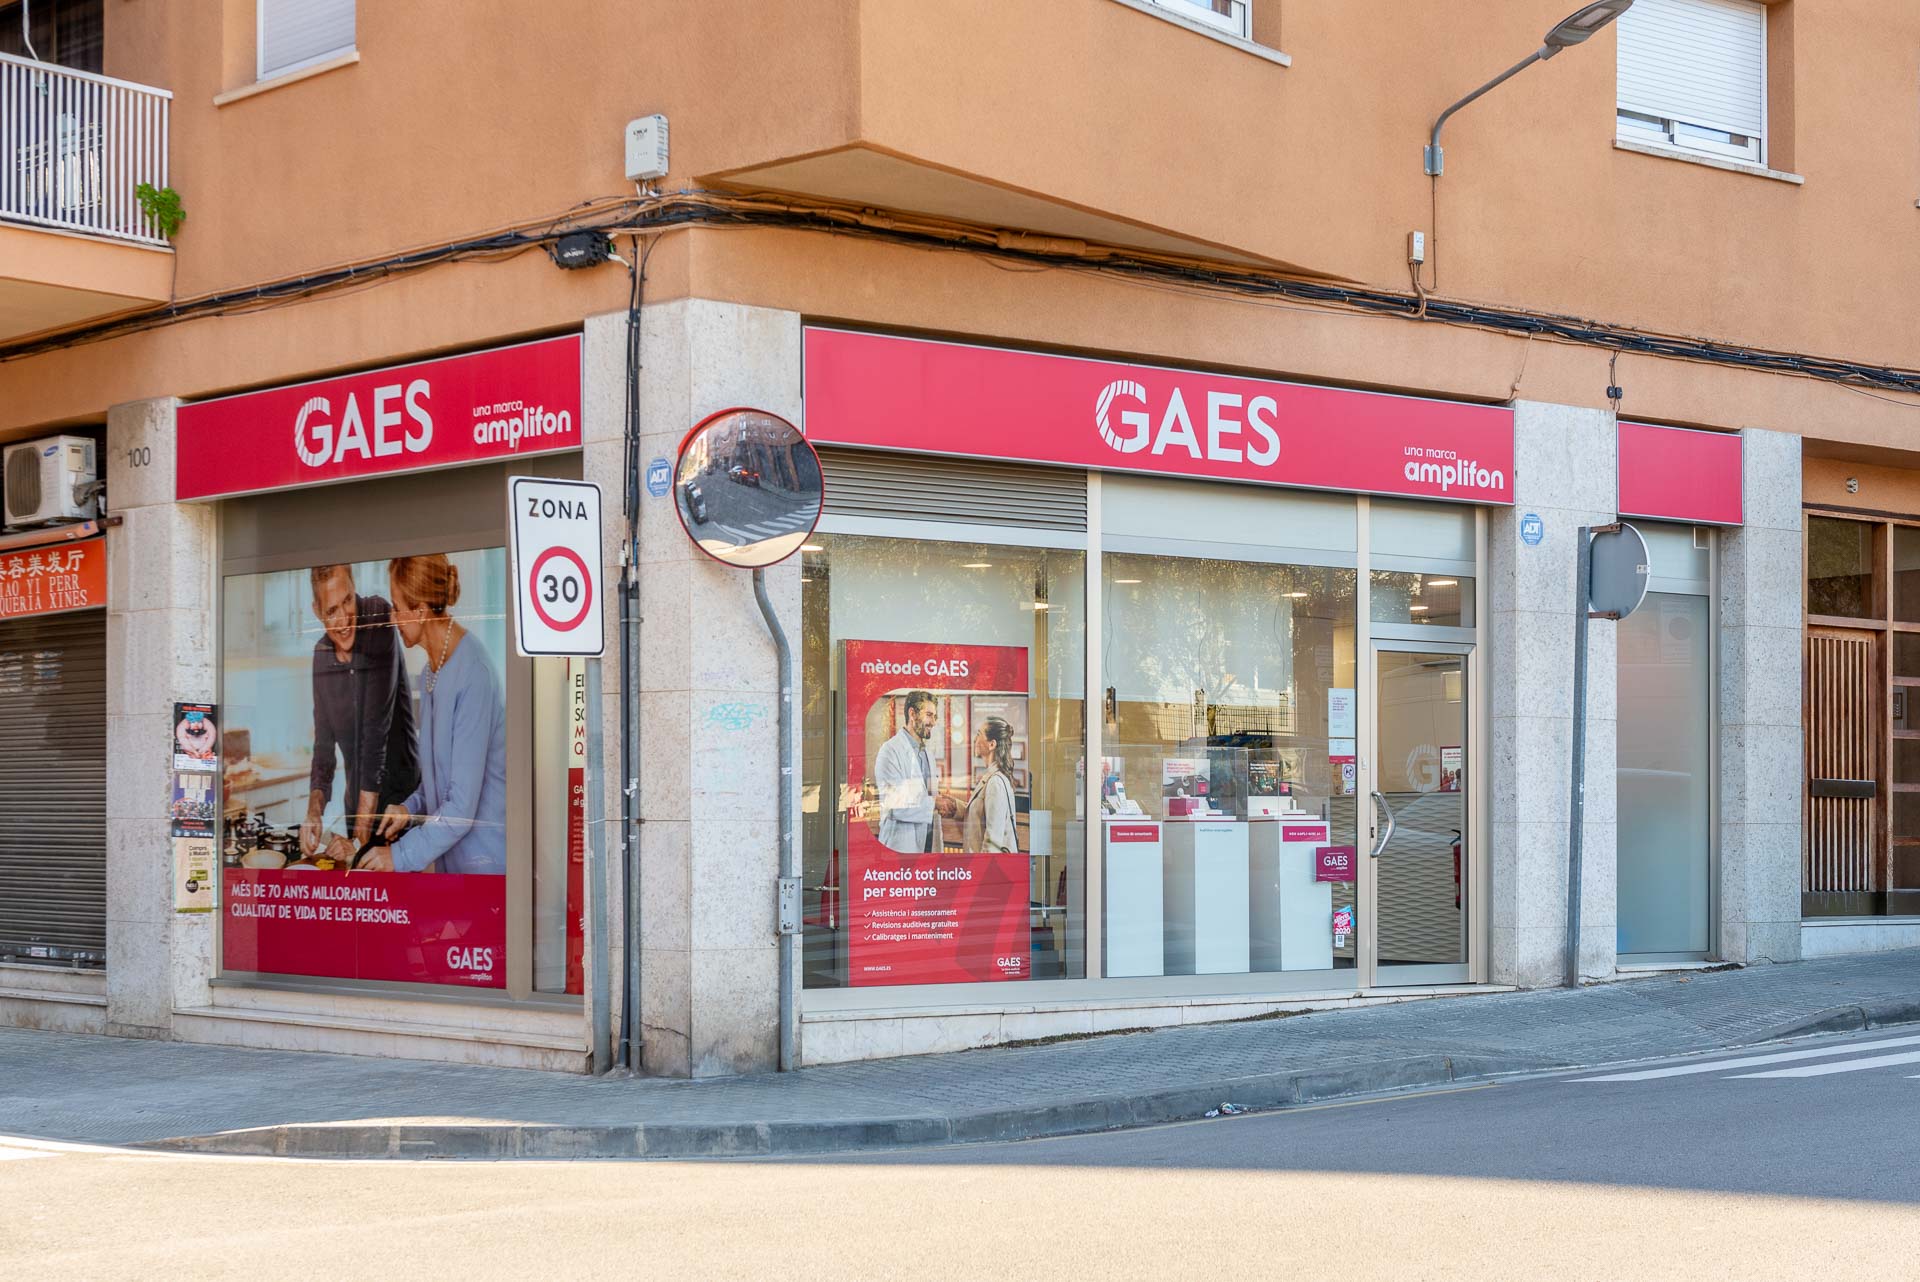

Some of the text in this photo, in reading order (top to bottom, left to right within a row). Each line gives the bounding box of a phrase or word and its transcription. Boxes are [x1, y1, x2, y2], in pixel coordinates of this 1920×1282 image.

[473, 400, 523, 417] una marca
[295, 379, 434, 468] GAES
[473, 405, 571, 448] amplifon
[1095, 379, 1281, 467] GAES
[128, 446, 151, 468] 100
[1404, 446, 1457, 460] una marca
[650, 469, 669, 483] ADT
[1404, 459, 1504, 492] amplifon
[528, 498, 588, 520] ZONA
[1523, 522, 1540, 534] ADT
[27, 578, 40, 595] YI
[49, 574, 79, 592] PERR
[542, 574, 579, 603] 30
[50, 589, 87, 608] XINES
[860, 658, 969, 677] mètode GAES
[1323, 855, 1348, 866] GAES
[863, 867, 972, 881] Atenció tot inclòs
[231, 880, 388, 902] MÉS DE 70 ANYS MILLORANT LA
[863, 886, 937, 901] per sempre
[231, 903, 411, 925] QUALITAT DE VIDA DE LES PERSONES.
[911, 909, 957, 917] assessorament
[871, 921, 901, 929] Revisions
[902, 921, 930, 929] auditives
[1335, 927, 1351, 935] 2020
[911, 932, 953, 940] manteniment
[446, 945, 493, 971] GAES
[996, 957, 1021, 967] GAES
